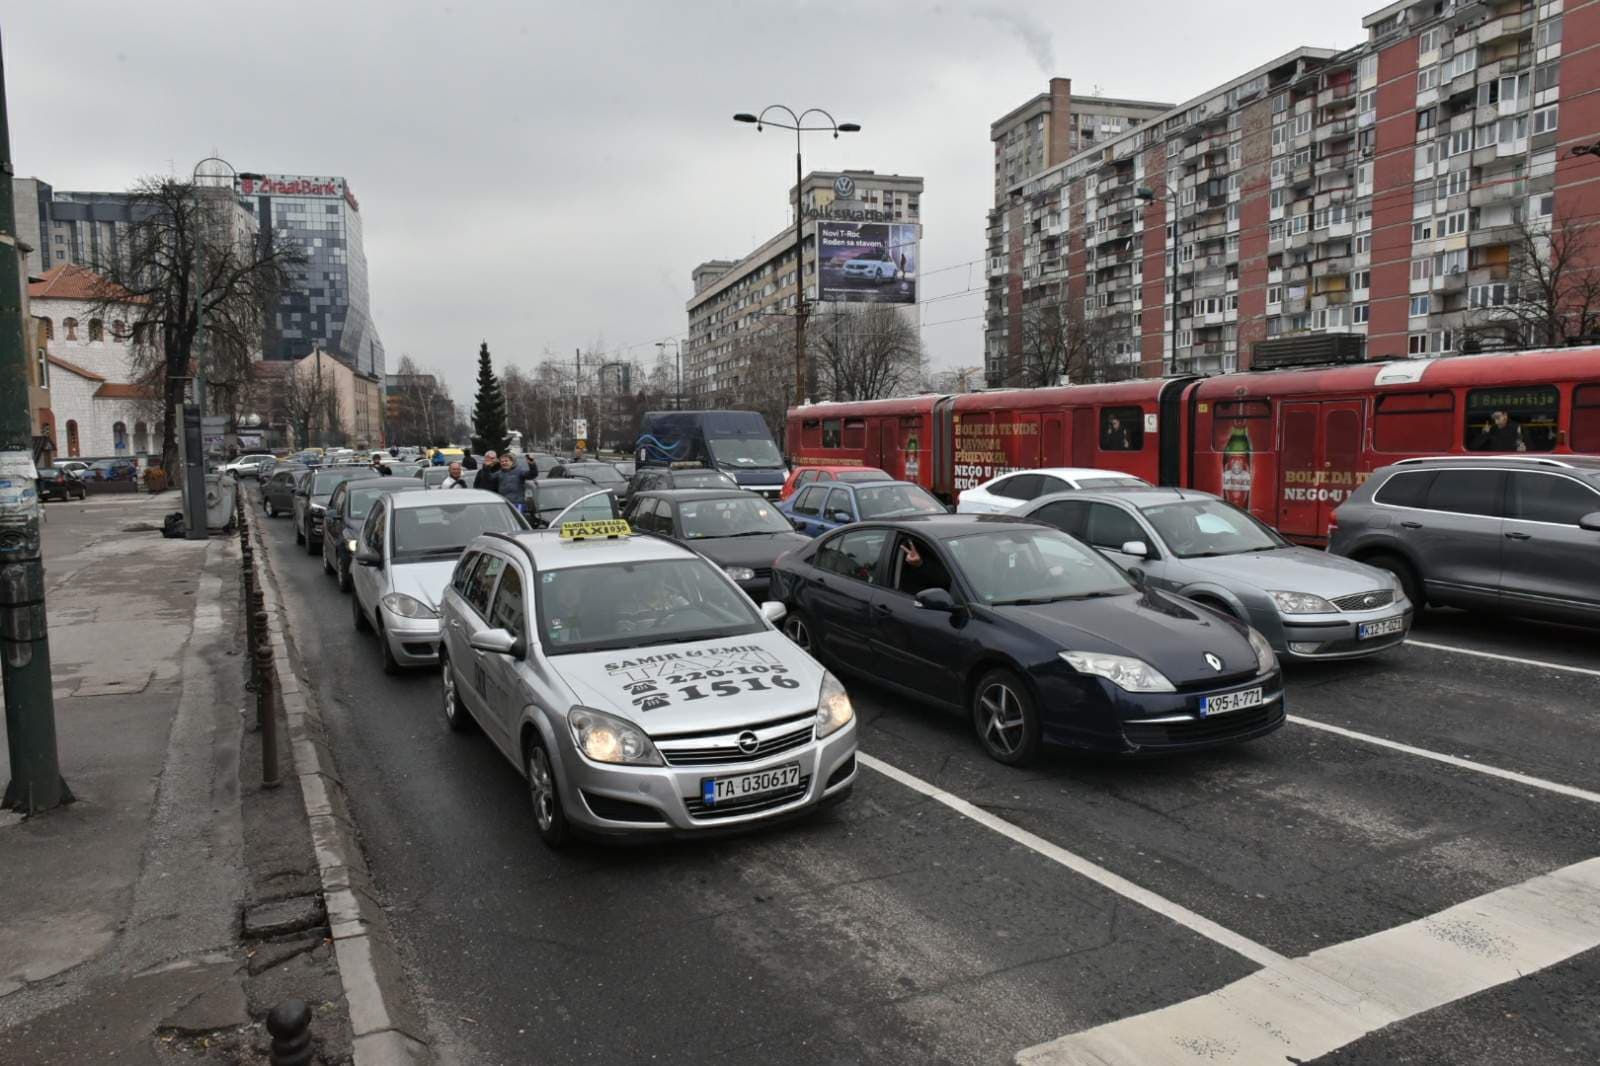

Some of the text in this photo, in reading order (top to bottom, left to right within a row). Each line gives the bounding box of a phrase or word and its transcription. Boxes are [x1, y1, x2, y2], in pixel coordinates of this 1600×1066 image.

[823, 230, 860, 238] Novi T-Roc
[954, 465, 983, 477] NEGO
[984, 466, 991, 478] U
[1285, 471, 1329, 486] BOLJE
[1331, 471, 1352, 485] DA
[1284, 487, 1328, 501] NEGO
[1333, 490, 1343, 502] U
[565, 527, 609, 536] TAXI
[604, 652, 682, 671] SAMIR
[706, 644, 763, 656] EMIR
[608, 651, 781, 681] TAXI
[665, 664, 789, 685] 220-105
[678, 675, 801, 702] 1516
[1208, 689, 1261, 713] K95-A-771
[715, 767, 798, 798] TA 030617
